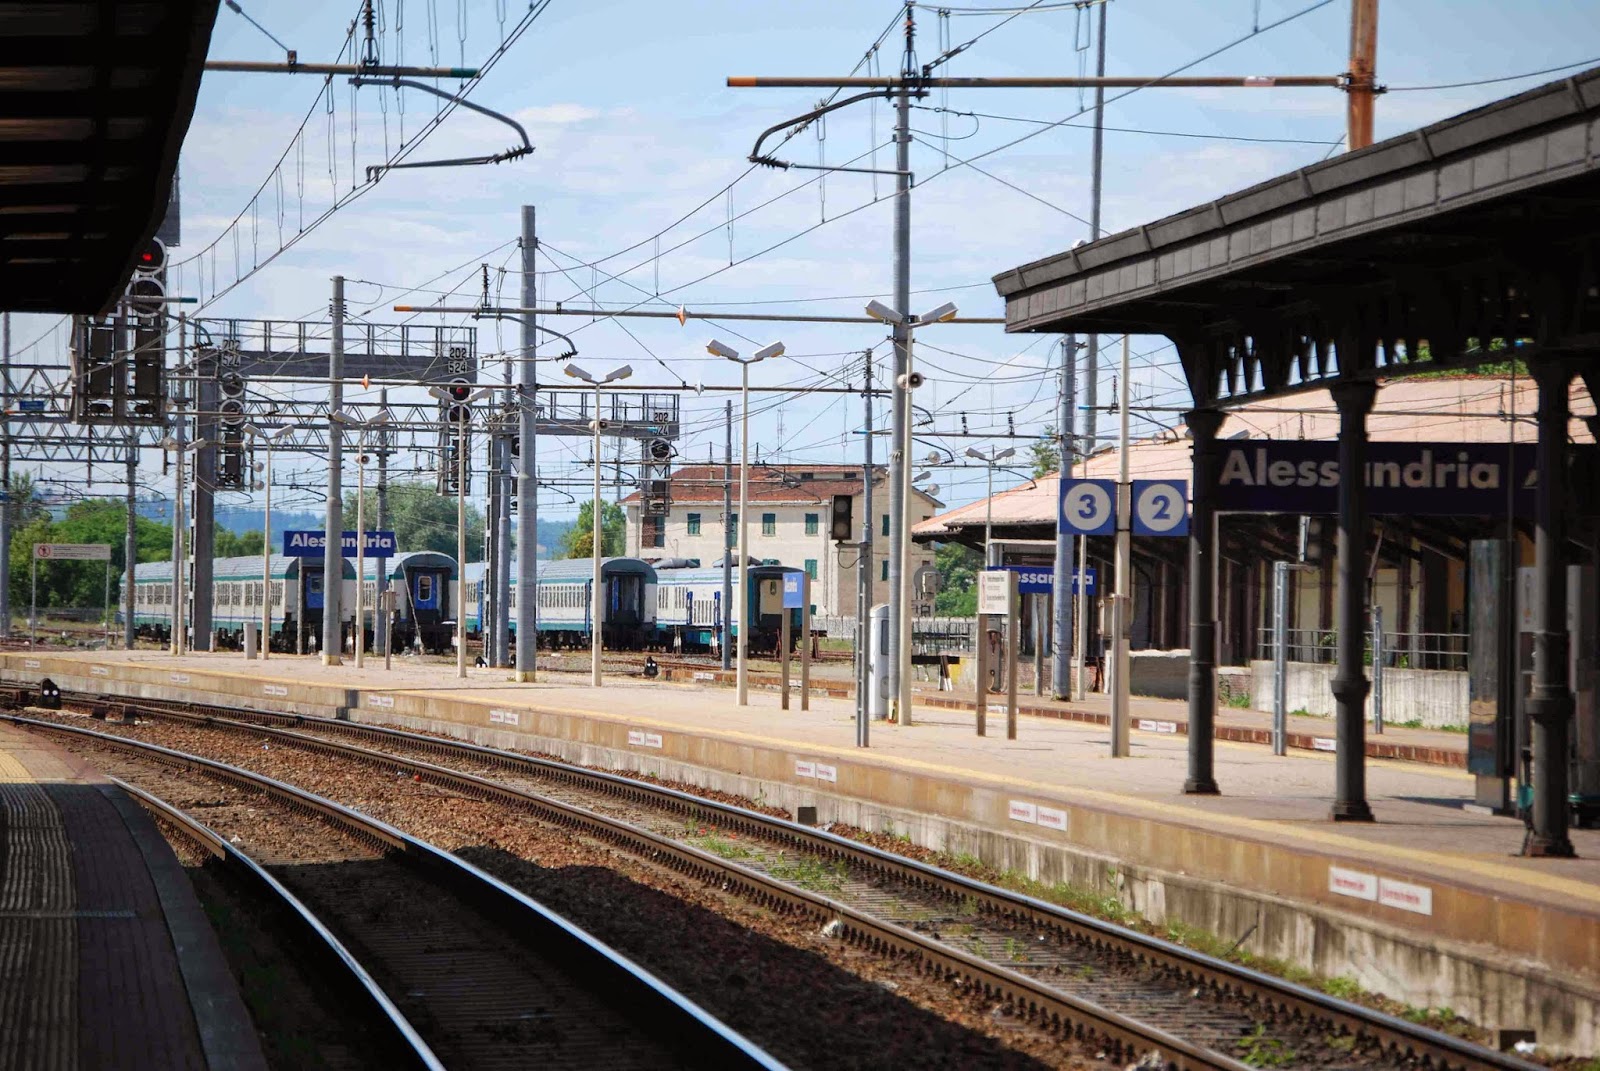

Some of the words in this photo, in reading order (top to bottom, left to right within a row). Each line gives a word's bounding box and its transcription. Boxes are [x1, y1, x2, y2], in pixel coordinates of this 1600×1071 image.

[449, 347, 467, 359] 202
[449, 361, 466, 373] 524
[654, 412, 669, 422] 202
[653, 424, 669, 436] 24
[1078, 493, 1097, 519] 3
[1151, 494, 1171, 519] 2
